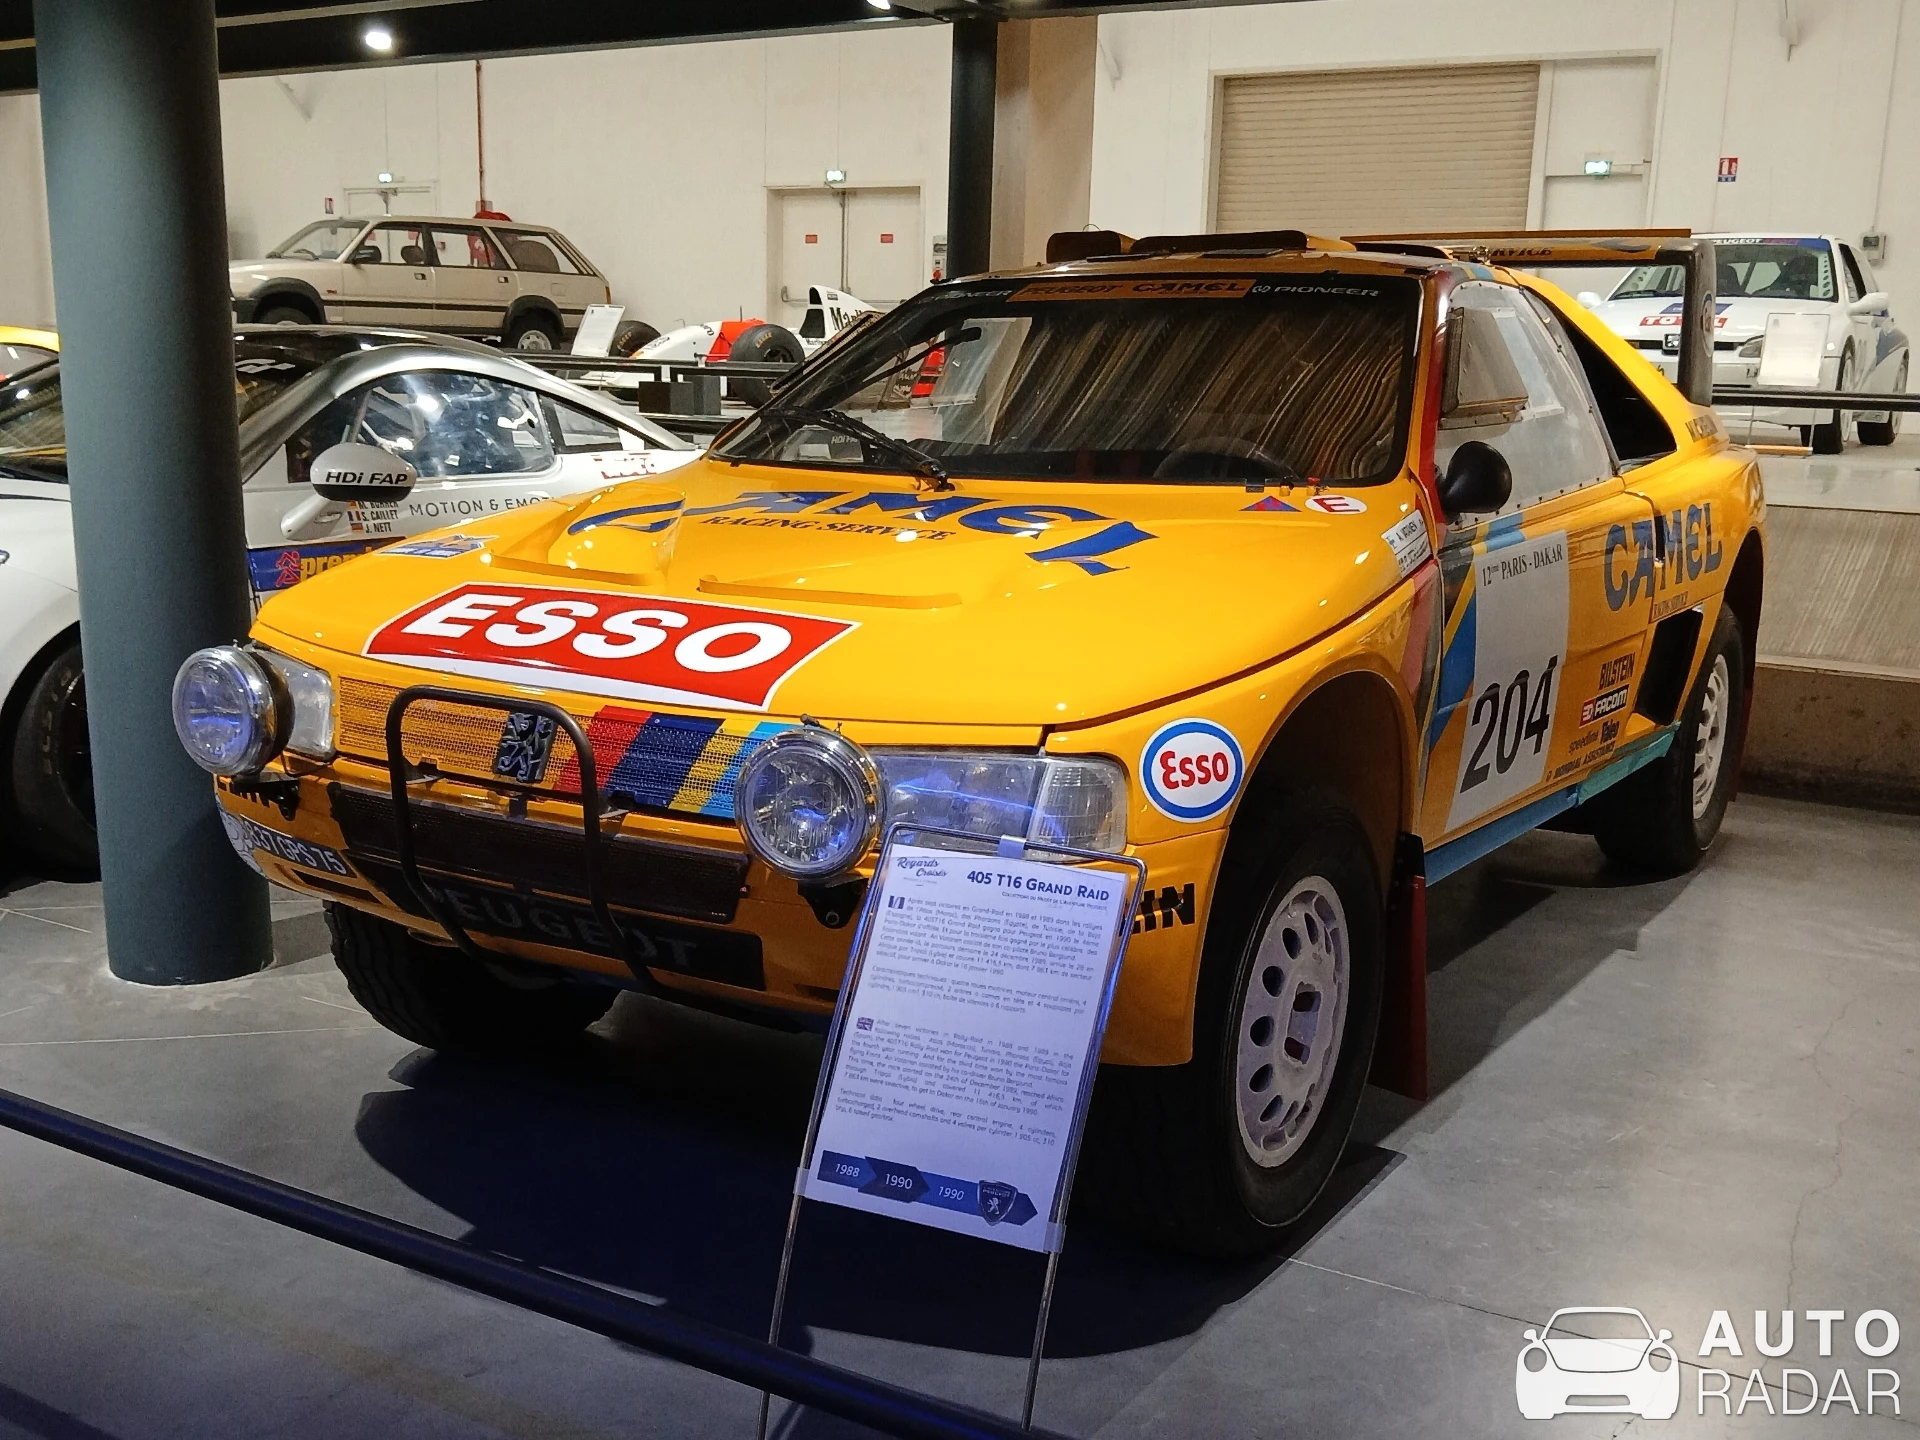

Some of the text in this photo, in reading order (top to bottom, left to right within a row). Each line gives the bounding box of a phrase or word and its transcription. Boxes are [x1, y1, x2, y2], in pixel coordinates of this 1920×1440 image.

[1132, 282, 1246, 293] CAMEL
[1274, 286, 1379, 297] PIONEER
[1641, 316, 1725, 328] TOL
[326, 471, 408, 486] HDi FAP
[370, 510, 398, 521] CAILLET
[409, 500, 483, 518] MOTION
[490, 498, 499, 511] &
[365, 522, 392, 534] J. NETT
[568, 491, 1160, 576] CAMEL
[700, 516, 958, 541] RACING SERVICE
[1502, 554, 1528, 580] PARIS
[1534, 544, 1563, 570] DAKAR
[1604, 502, 1723, 612] CAMEL
[400, 594, 794, 673] ESSO
[1598, 652, 1636, 690] BILSTEIN
[1594, 688, 1628, 717] FACOM
[1460, 655, 1558, 795] 204
[1159, 750, 1229, 790] ESSO
[277, 836, 319, 868] GPS
[311, 848, 347, 874] 75
[896, 856, 939, 870] Regards
[966, 870, 1110, 902] 405 T16 GRAND RAID
[835, 1162, 861, 1178] 1988
[884, 1172, 913, 1190] 1990
[938, 1186, 964, 1201] 1990
